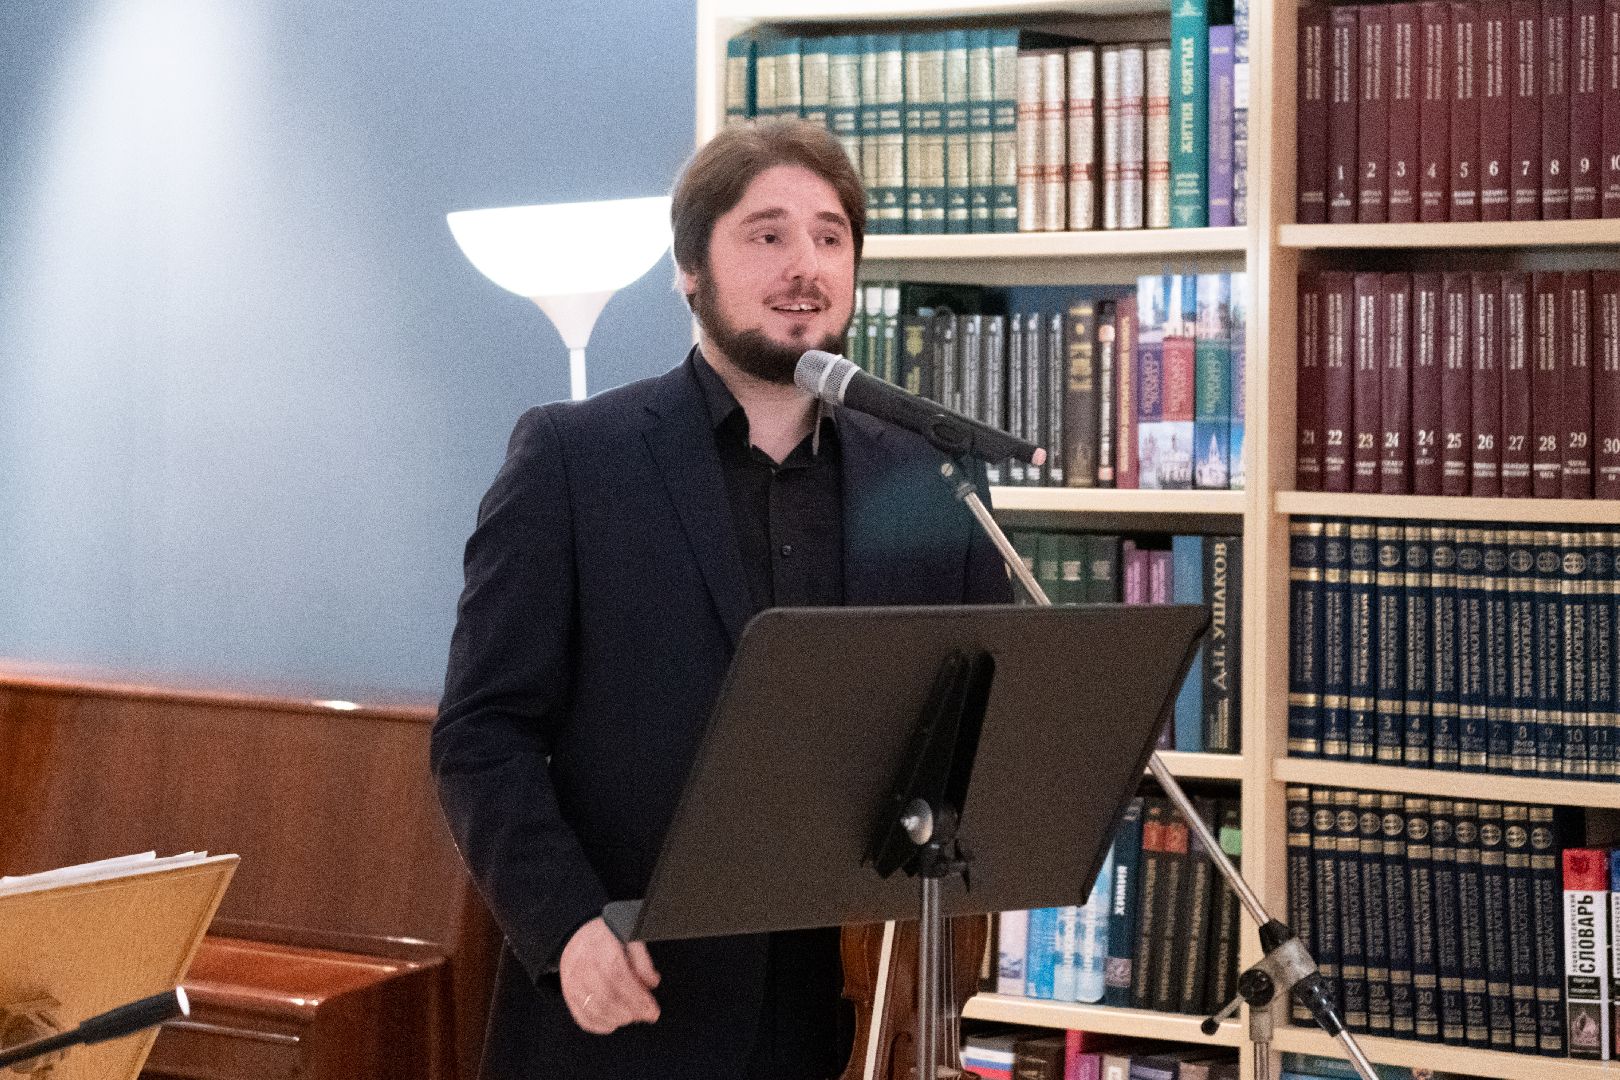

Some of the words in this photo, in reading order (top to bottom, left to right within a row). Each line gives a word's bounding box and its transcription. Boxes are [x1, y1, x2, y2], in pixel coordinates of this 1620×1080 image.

[1182, 37, 1194, 95] СВЯТЫХ
[1182, 103, 1194, 153] ЖИТИЯ
[1338, 165, 1344, 180] 1
[1366, 162, 1376, 178] 2
[1396, 161, 1406, 177] 3
[1428, 162, 1437, 178] 4
[1460, 162, 1468, 178] 5
[1488, 160, 1498, 176] 6
[1522, 160, 1530, 176] 7
[1550, 160, 1560, 175] 8
[1580, 158, 1590, 173] 9
[1328, 430, 1342, 446] 22
[1358, 433, 1374, 449] 23
[1385, 432, 1399, 448] 24
[1418, 430, 1434, 446] 24
[1446, 432, 1462, 449] 25
[1477, 434, 1494, 450] 26
[1508, 436, 1524, 451] 27
[1539, 436, 1556, 452] 28
[1569, 432, 1588, 448] 29
[1602, 438, 1620, 454] 30
[1212, 542, 1228, 640] УШАКОВ
[1356, 714, 1364, 726] 2
[1384, 716, 1392, 730] 3
[1412, 718, 1420, 730] 4
[1441, 719, 1448, 732] 5
[1466, 723, 1476, 734] 6
[1518, 726, 1528, 739] 8
[1568, 729, 1583, 742] 10
[1593, 730, 1608, 742] 11
[1114, 865, 1128, 916] ХИМИЯ
[1578, 894, 1596, 974] СЛОВАРЬ
[1346, 982, 1361, 996] 27
[1418, 991, 1433, 1004] 30
[1468, 996, 1482, 1008] 32
[1515, 1003, 1530, 1016] 34
[1540, 1004, 1556, 1018] 35
